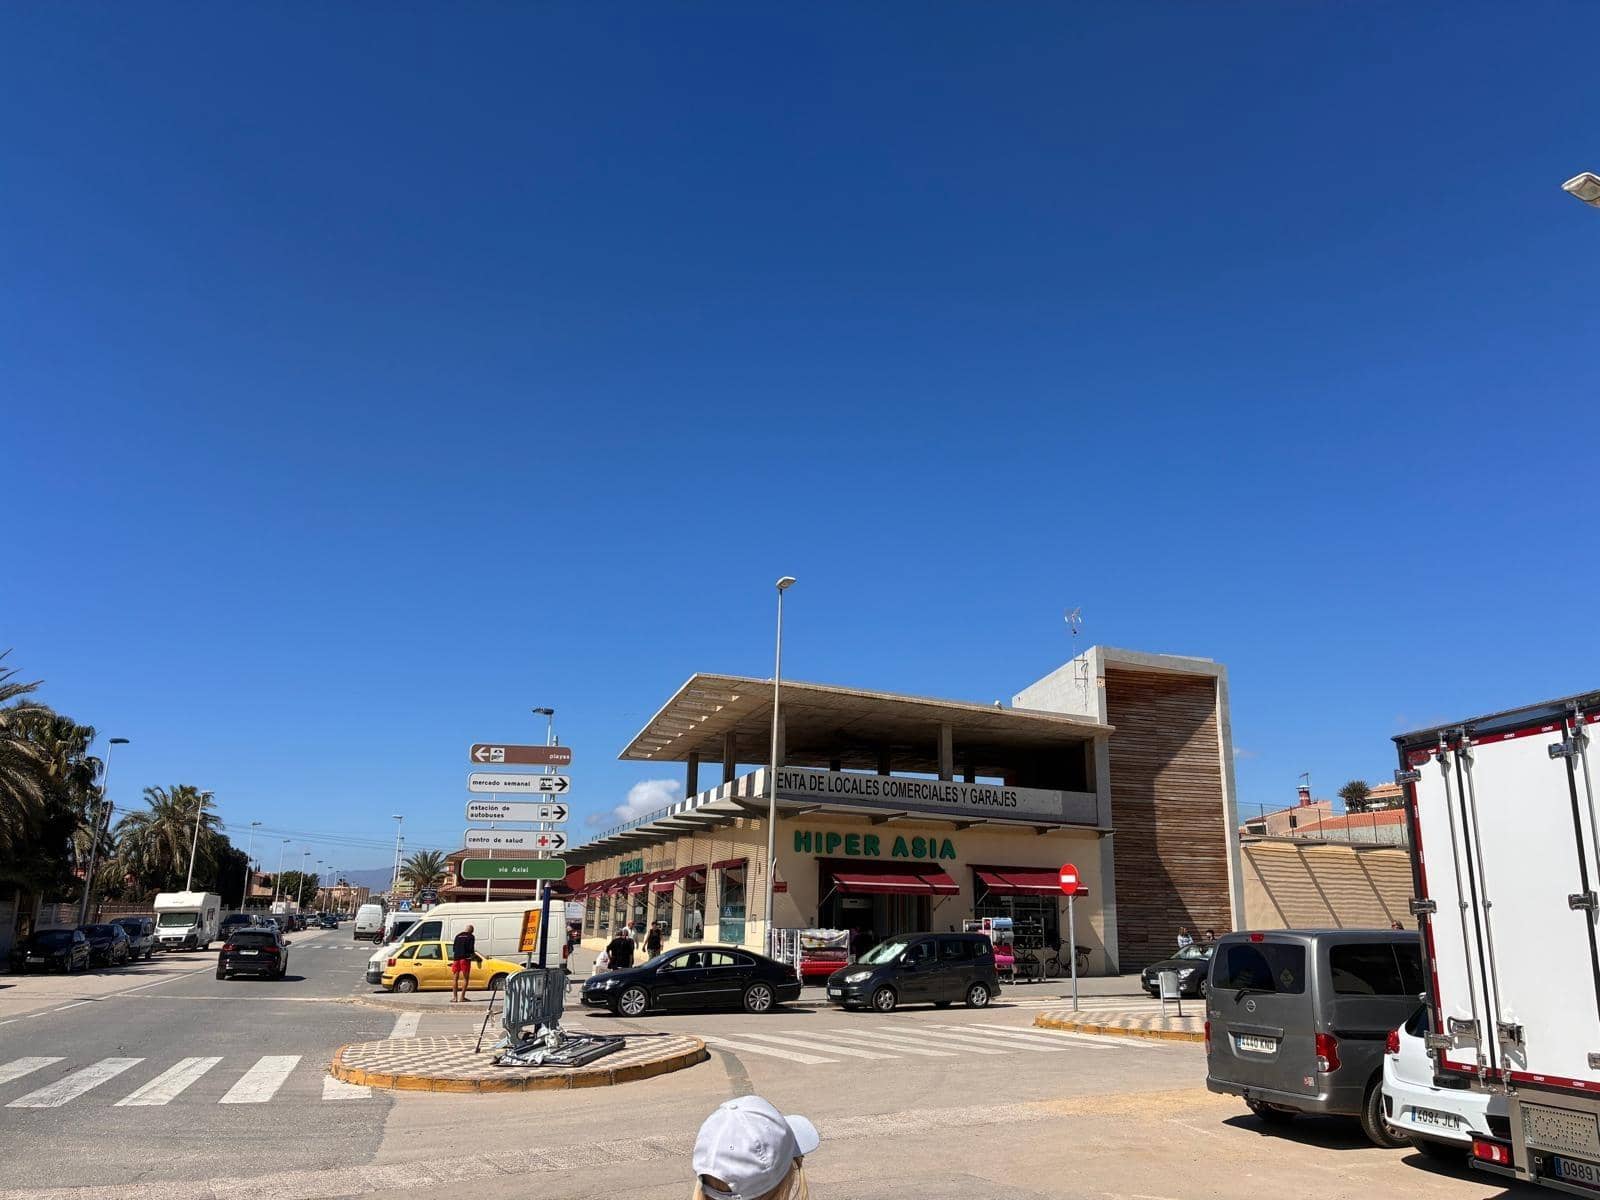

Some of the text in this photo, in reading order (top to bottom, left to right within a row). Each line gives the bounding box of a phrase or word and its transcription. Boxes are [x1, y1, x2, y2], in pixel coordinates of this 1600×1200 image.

[769, 772, 1017, 808] ENTA DE LOCALES COMERCIALES Y GARAJES
[794, 830, 956, 860] HIPER ASIA
[1241, 1035, 1258, 1049] 4440
[1417, 1109, 1460, 1129] 4094 JLN
[1563, 1161, 1593, 1181] 0989
